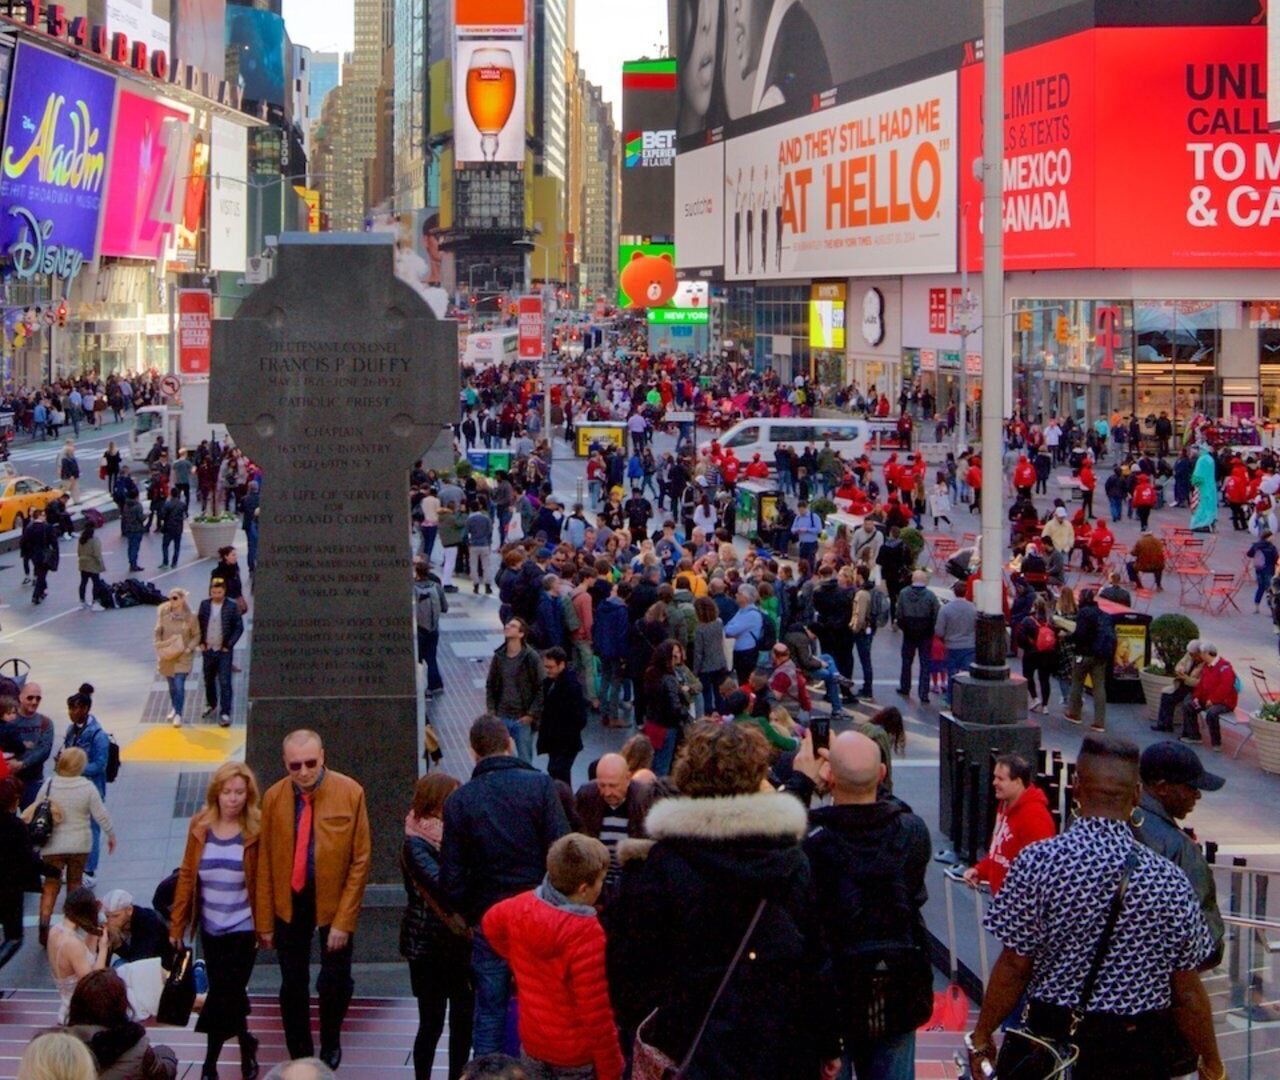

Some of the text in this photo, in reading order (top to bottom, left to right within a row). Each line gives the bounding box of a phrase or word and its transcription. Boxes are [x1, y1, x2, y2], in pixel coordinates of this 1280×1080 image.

[112, 32, 244, 110] BROADWAY
[980, 73, 1070, 124] LIMITED
[642, 130, 676, 148] BET
[778, 99, 940, 165] AND THEY STILL HAD ME
[1020, 124, 1027, 148] &
[1030, 115, 1070, 146] TEXTS
[1188, 107, 1268, 135] CALL
[4, 92, 104, 192] Aladdin
[1187, 142, 1246, 181] TO
[1003, 148, 1071, 192] MEXICO
[783, 172, 812, 235] AT
[1003, 190, 1070, 233] ANADA
[1186, 186, 1218, 227] &
[664, 311, 684, 320] NEW
[259, 357, 330, 373] FRANCIS
[353, 357, 412, 373] DUFFY
[278, 396, 391, 408] CATHOLIC PRIEST
[344, 490, 391, 500] SERVICE
[306, 514, 333, 525] AND
[337, 514, 393, 525] COUNTRY
